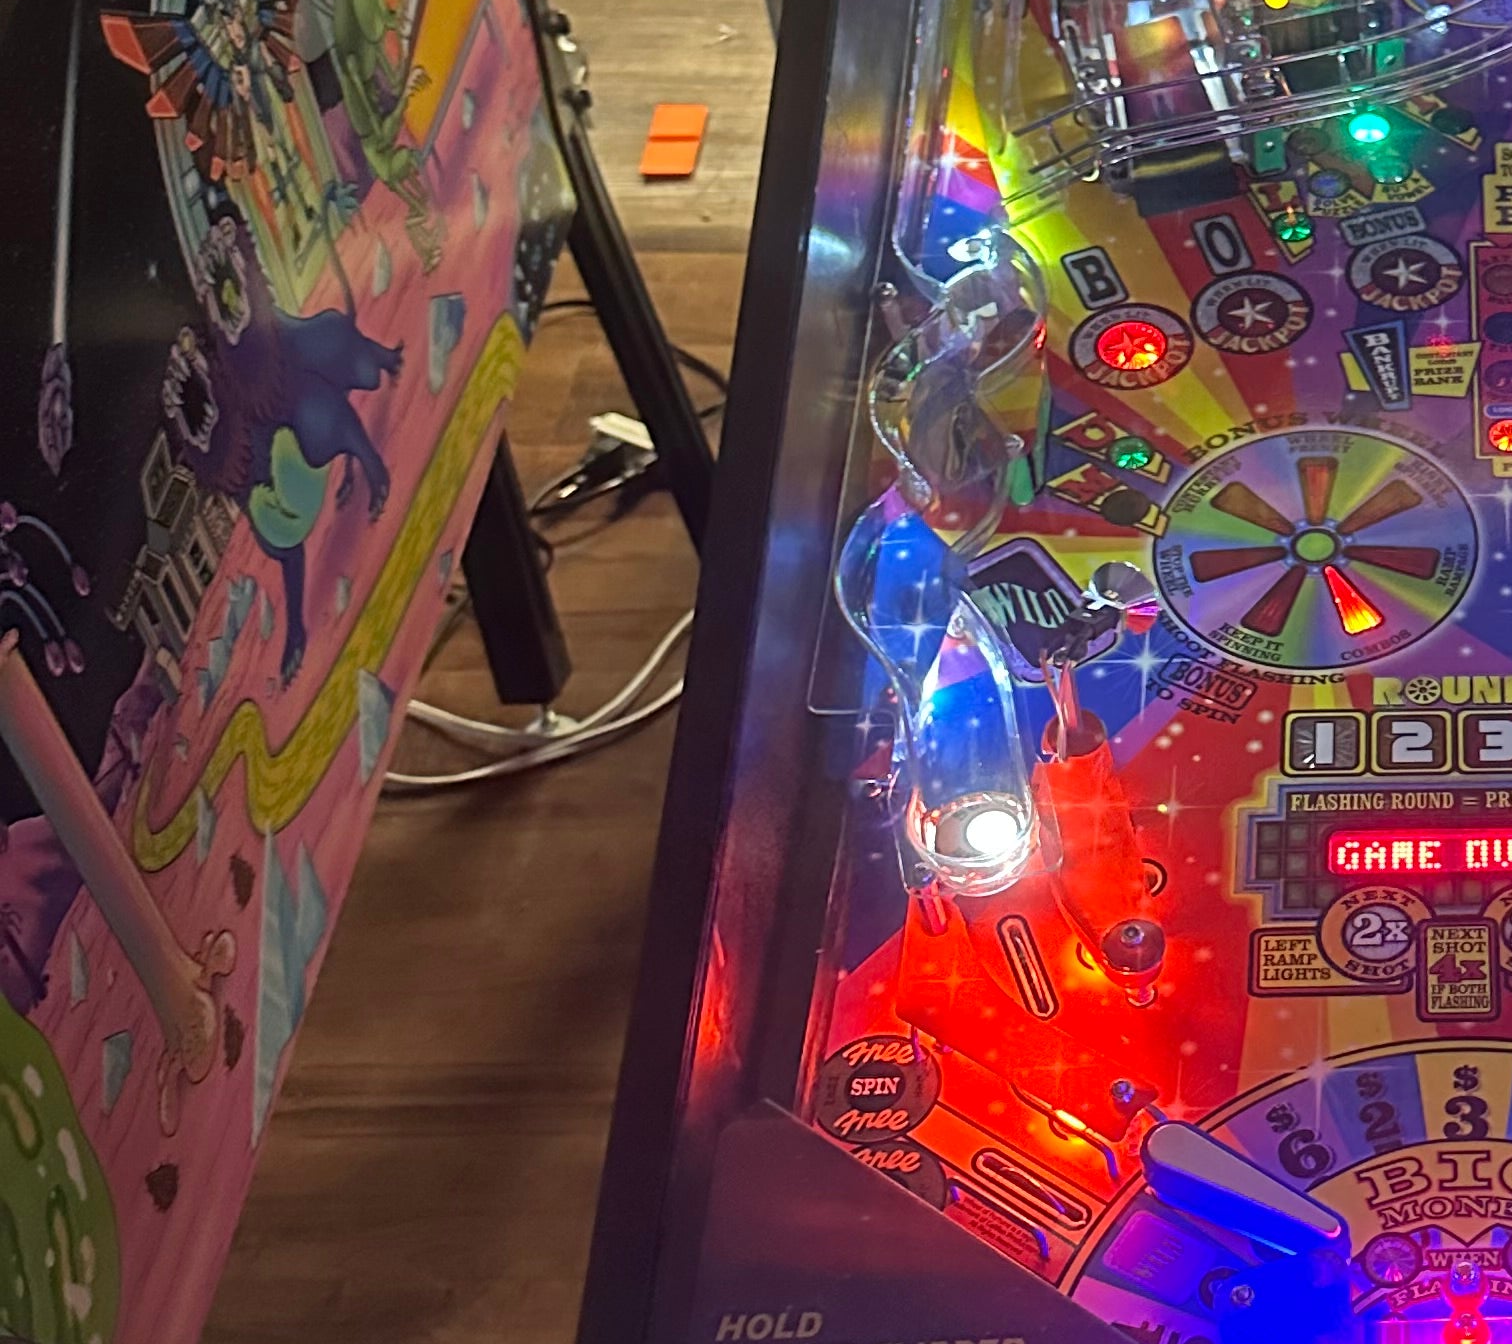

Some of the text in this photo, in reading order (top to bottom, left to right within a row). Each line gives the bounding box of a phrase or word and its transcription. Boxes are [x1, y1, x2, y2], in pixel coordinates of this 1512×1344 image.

[1350, 212, 1420, 239] BONUS
[1071, 254, 1118, 301] B
[1361, 264, 1463, 311] JACKPOT
[1207, 301, 1309, 352] JACKPOT
[1086, 333, 1190, 388] JACKPOT
[1362, 333, 1400, 401] BANKRUPT
[1414, 367, 1464, 376] PRIZE
[1414, 376, 1465, 386] BANK
[1184, 412, 1308, 462] BONUS
[1435, 545, 1458, 587] RAMP
[968, 581, 1072, 630] WILD
[1208, 629, 1282, 663] SPINNING
[1219, 622, 1285, 653] KEEP IT
[1340, 629, 1412, 661] COMBOS
[1168, 661, 1248, 704] BONUS
[1216, 657, 1346, 686] FLASHING
[1177, 697, 1242, 724] SPIN
[1301, 721, 1335, 766] 1
[1391, 720, 1433, 763] 2
[1291, 791, 1386, 813] FLASHING
[1391, 791, 1455, 811] ROUND
[1336, 839, 1443, 872] GAME
[1340, 886, 1419, 912] NEXT
[1262, 939, 1312, 952] LEFT
[1430, 927, 1487, 941] NEXT
[1431, 941, 1488, 954] SHOT
[1261, 966, 1332, 982] LIGHTS
[1263, 953, 1319, 967] RAMP
[1345, 958, 1410, 979] SHOT
[1430, 983, 1488, 995] IF BOTH
[1430, 995, 1490, 1011] FLASHING
[842, 1041, 916, 1067] Free
[850, 1076, 900, 1096] SPIN
[1442, 1064, 1491, 1141] $3
[832, 1108, 910, 1136] Free
[1429, 1249, 1501, 1267] WHEN
[715, 1311, 823, 1342] HOLD
